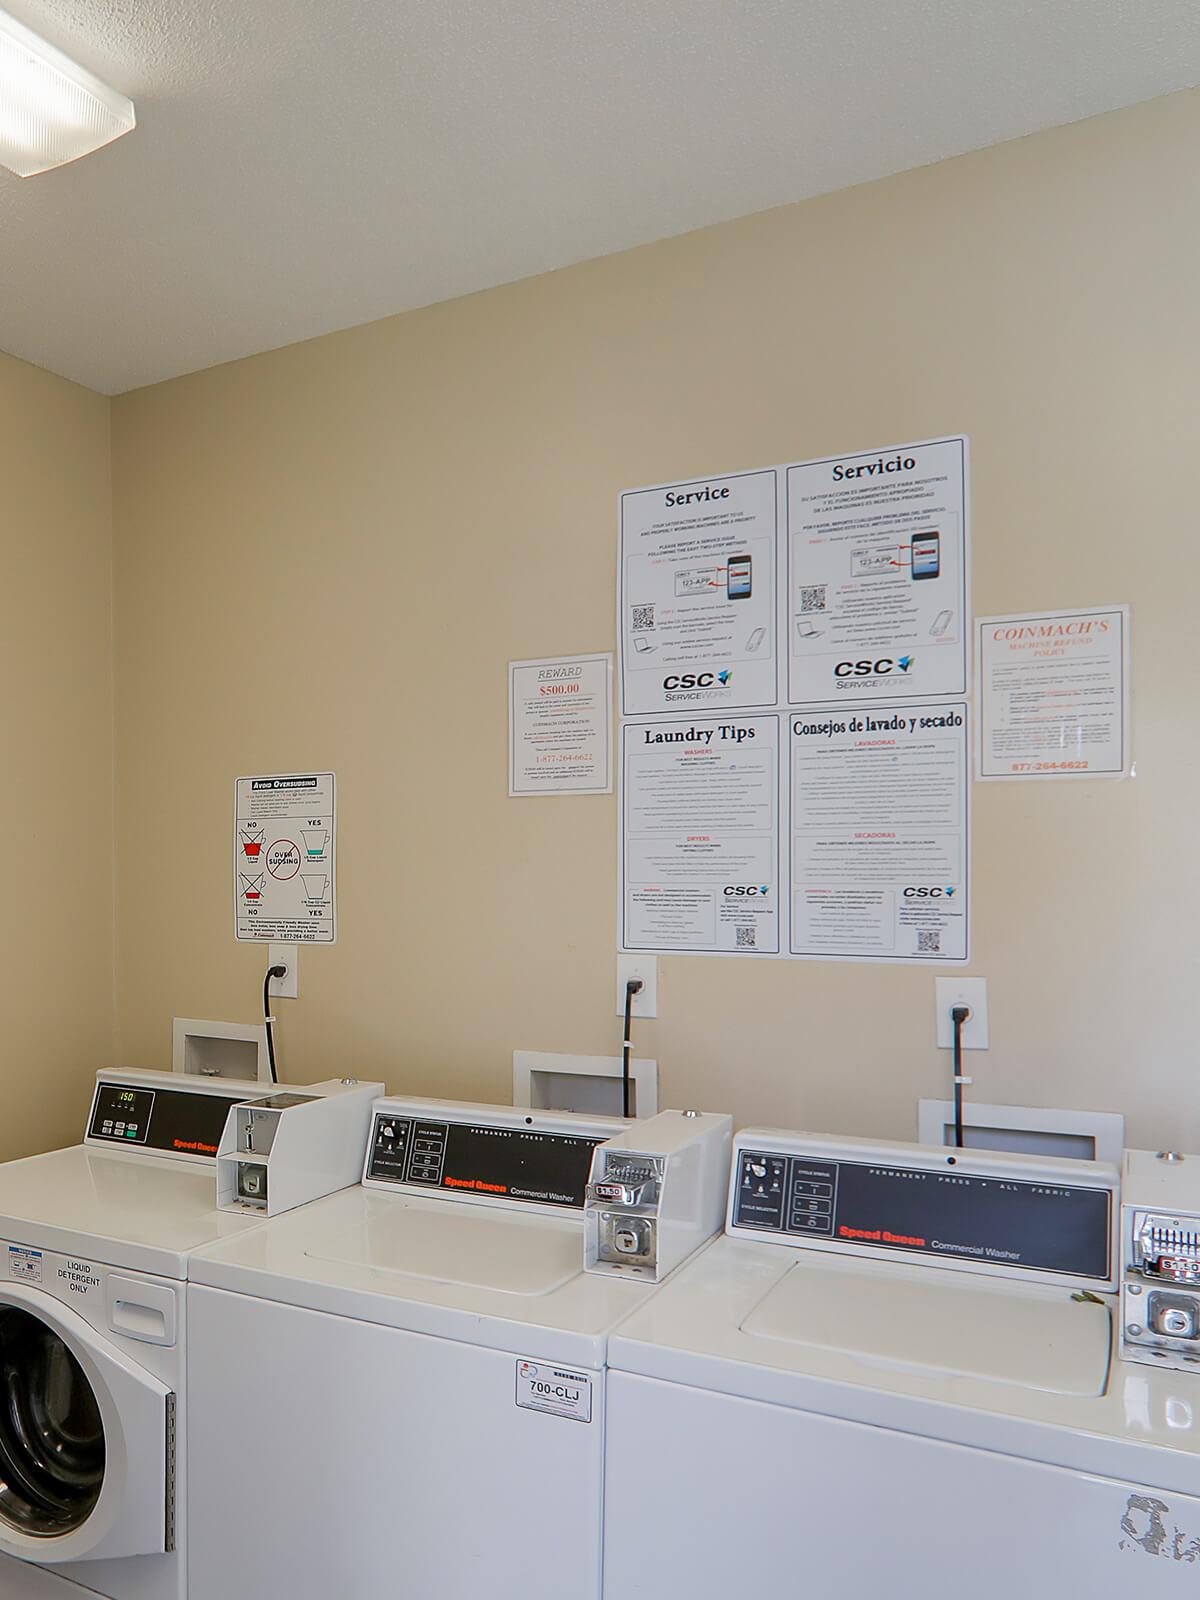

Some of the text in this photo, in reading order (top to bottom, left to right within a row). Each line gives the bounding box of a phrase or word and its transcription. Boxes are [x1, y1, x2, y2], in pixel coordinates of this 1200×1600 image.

[832, 456, 916, 481] Servicio
[665, 487, 730, 507] Service
[993, 620, 1109, 641] COINMACH'S
[538, 667, 582, 679] REWARD
[834, 659, 893, 677] CSC
[663, 672, 714, 690] CSC
[539, 684, 580, 696] $500.00
[793, 712, 962, 738] Consejos de lavado y secado
[644, 725, 755, 745] Laundry Tips
[854, 739, 896, 747] LAVADORAS
[684, 748, 713, 756] WASHERS
[723, 886, 758, 896] CSC
[903, 887, 942, 897] CSC
[120, 1092, 134, 1102] 150
[470, 1129, 512, 1138] PERMANENT
[174, 1139, 196, 1149] Speed
[444, 1176, 574, 1203] Speed Queen Commercial Washer
[870, 1169, 926, 1180] PERMANENT
[938, 1177, 970, 1185] PRESS
[1031, 1187, 1070, 1197] FABRIC
[597, 1187, 620, 1195] $1.50
[840, 1225, 1021, 1260] Speed Queen Commercial Washer
[67, 1261, 91, 1273] LIQUID
[58, 1269, 100, 1286] DETERGENT
[70, 1283, 88, 1293] ONLY
[530, 1380, 579, 1401] 700-CLJ
